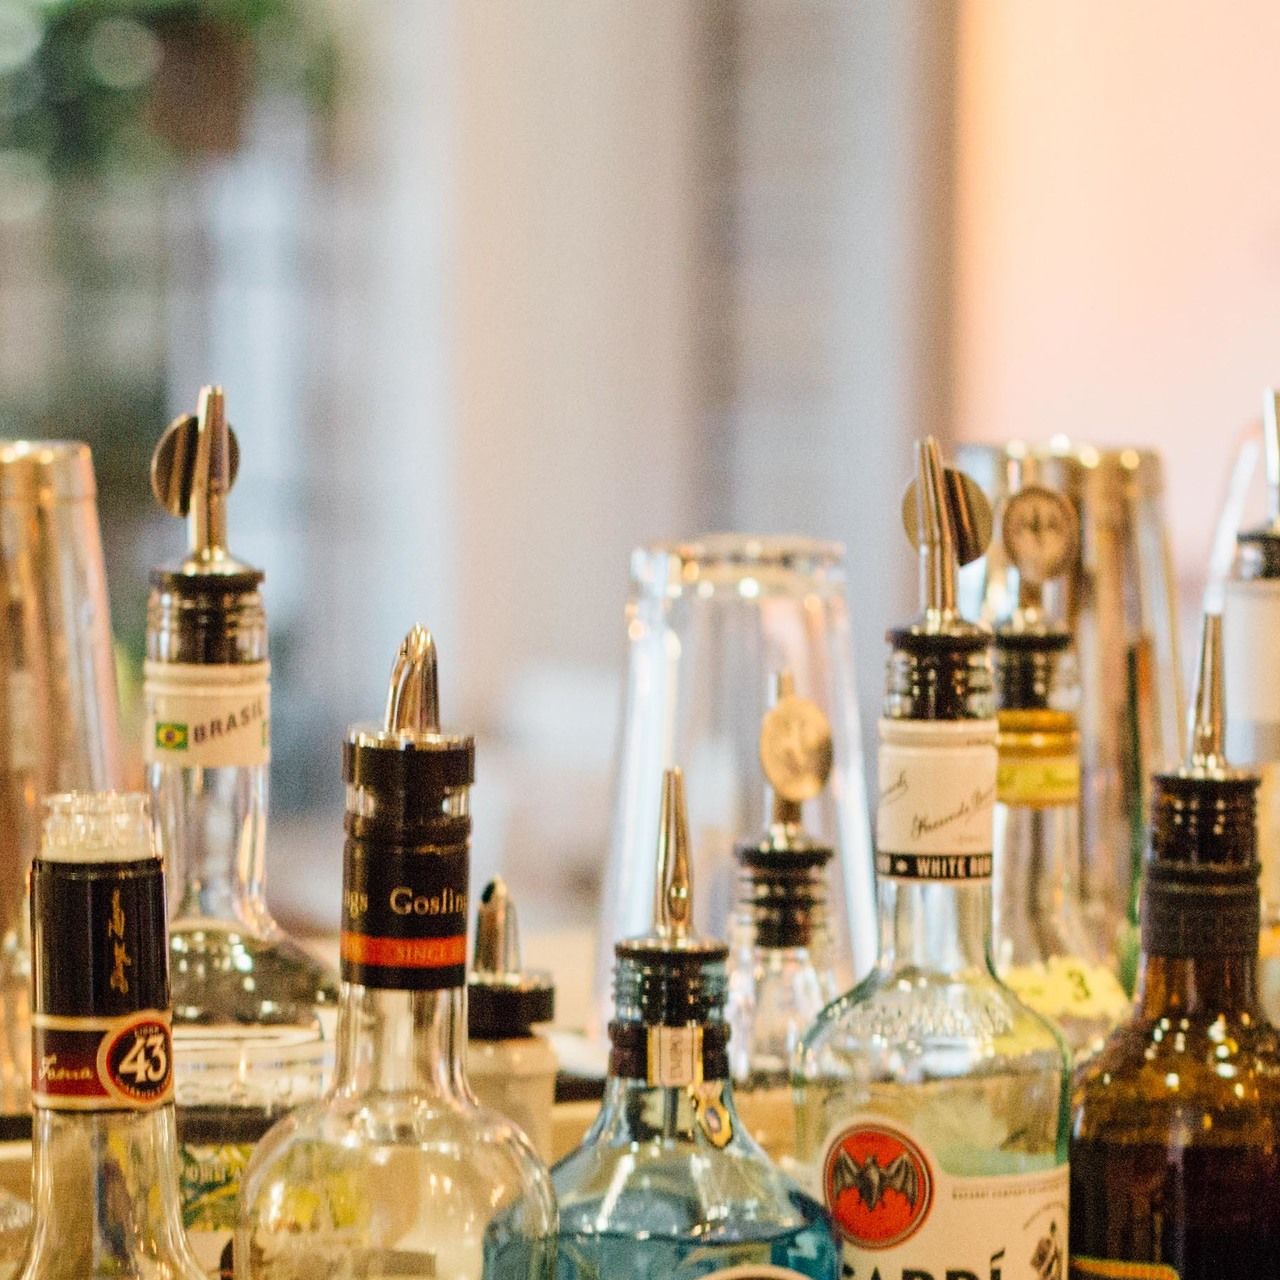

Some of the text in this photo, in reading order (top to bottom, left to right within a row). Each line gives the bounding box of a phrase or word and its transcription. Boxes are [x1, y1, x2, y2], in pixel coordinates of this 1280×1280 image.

[917, 855, 967, 877] WHITE
[389, 885, 467, 916] Goslin
[118, 1032, 167, 1083] 43
